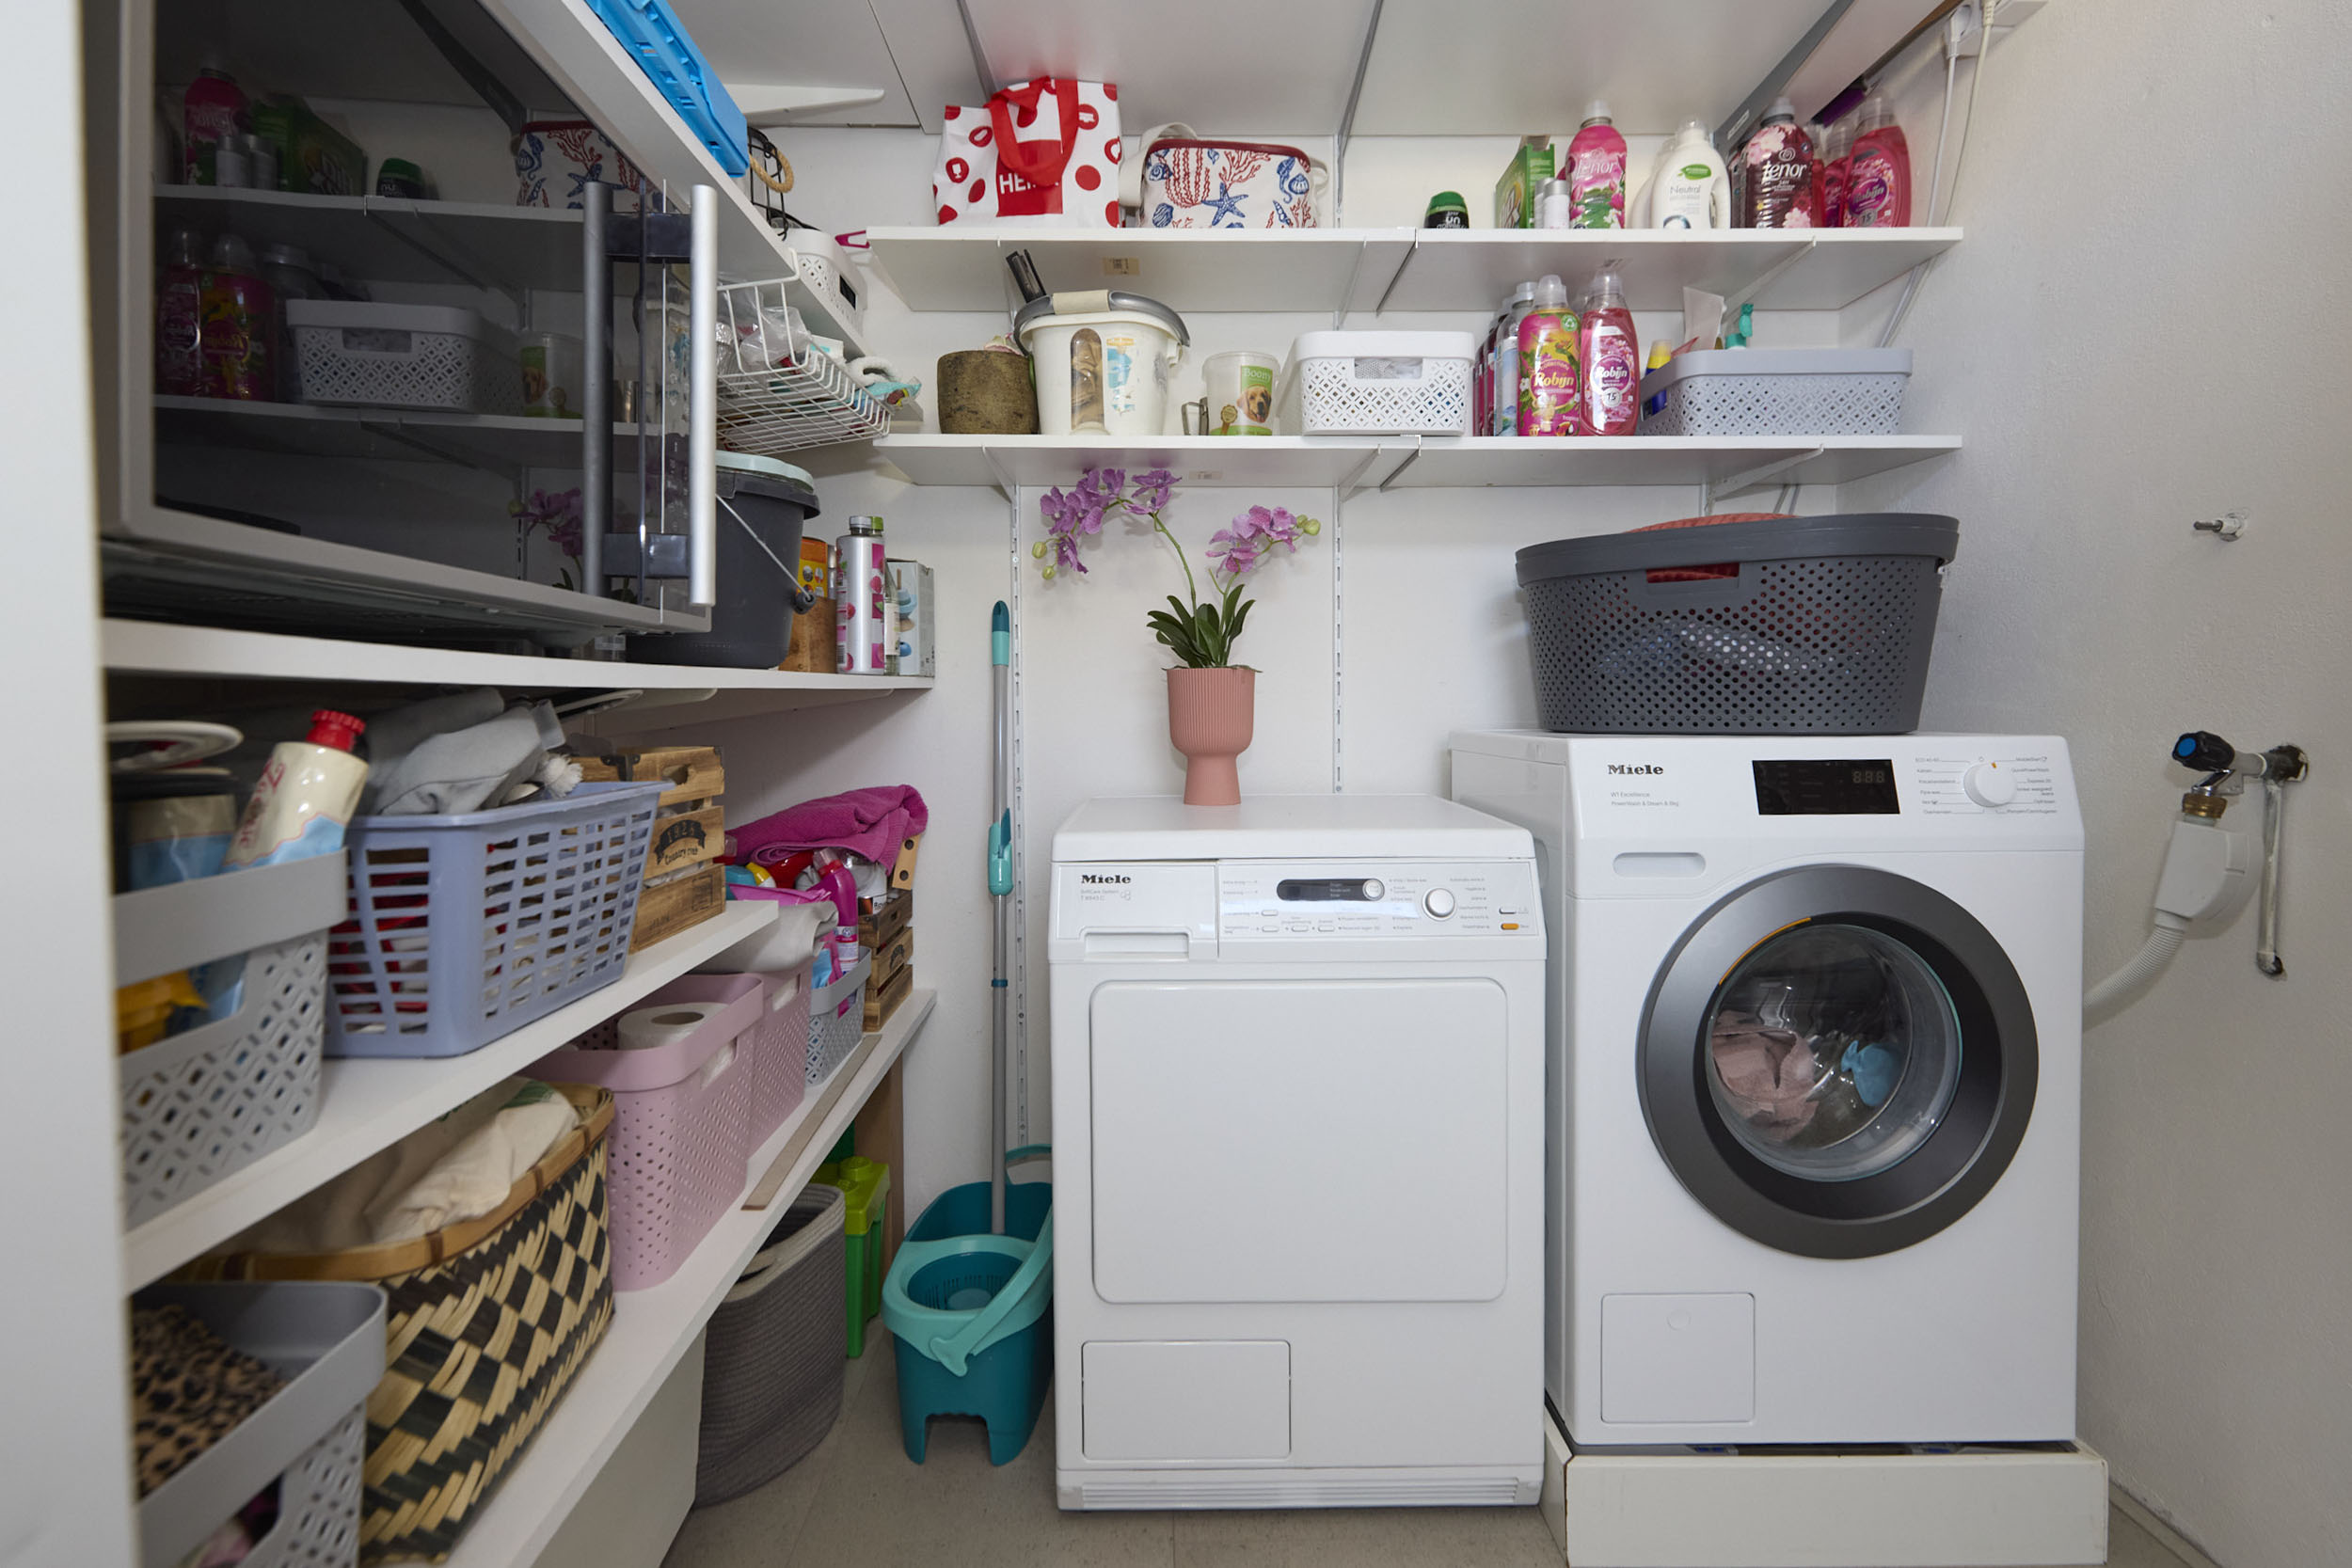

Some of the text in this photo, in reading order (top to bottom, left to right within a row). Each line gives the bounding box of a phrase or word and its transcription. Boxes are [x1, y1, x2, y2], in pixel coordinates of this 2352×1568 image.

[1760, 160, 1807, 184] Lenor
[1670, 185, 1701, 194] Neutral
[1595, 366, 1628, 379] Robijn
[1534, 372, 1574, 388] Robijn
[1607, 392, 1616, 401] 15
[1607, 764, 1664, 775] Miele
[1080, 874, 1132, 884] Miele
